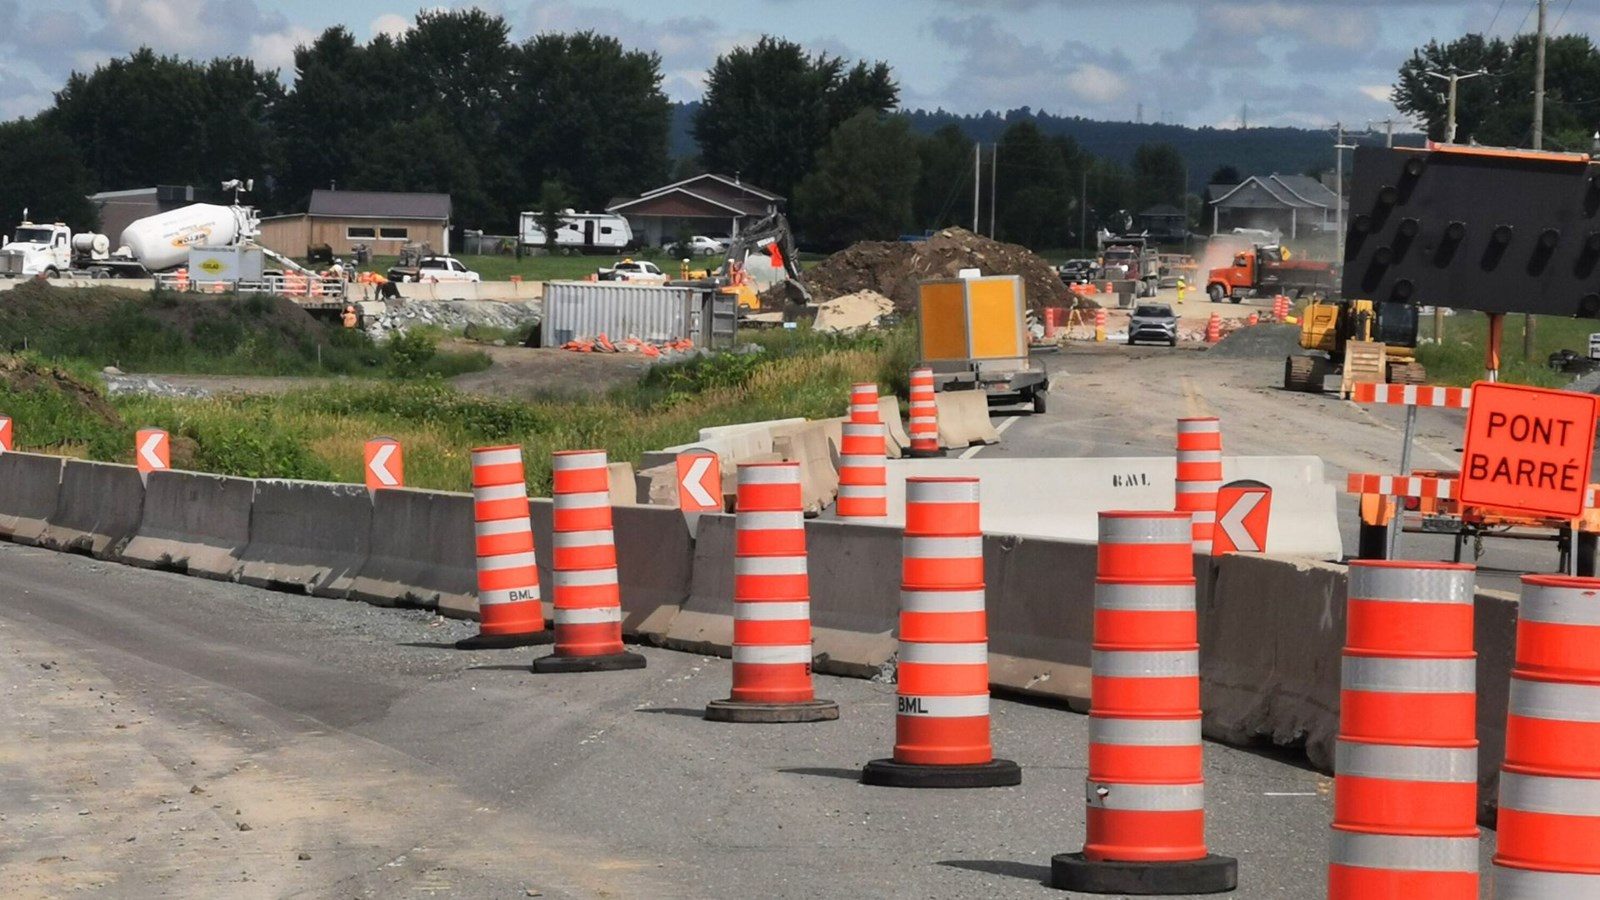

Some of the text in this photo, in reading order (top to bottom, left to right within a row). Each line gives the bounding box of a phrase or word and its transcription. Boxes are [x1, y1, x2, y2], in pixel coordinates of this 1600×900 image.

[1488, 411, 1574, 447] PONT
[1469, 454, 1580, 492] BARRÉ
[509, 588, 534, 602] BML
[898, 697, 928, 714] BML
